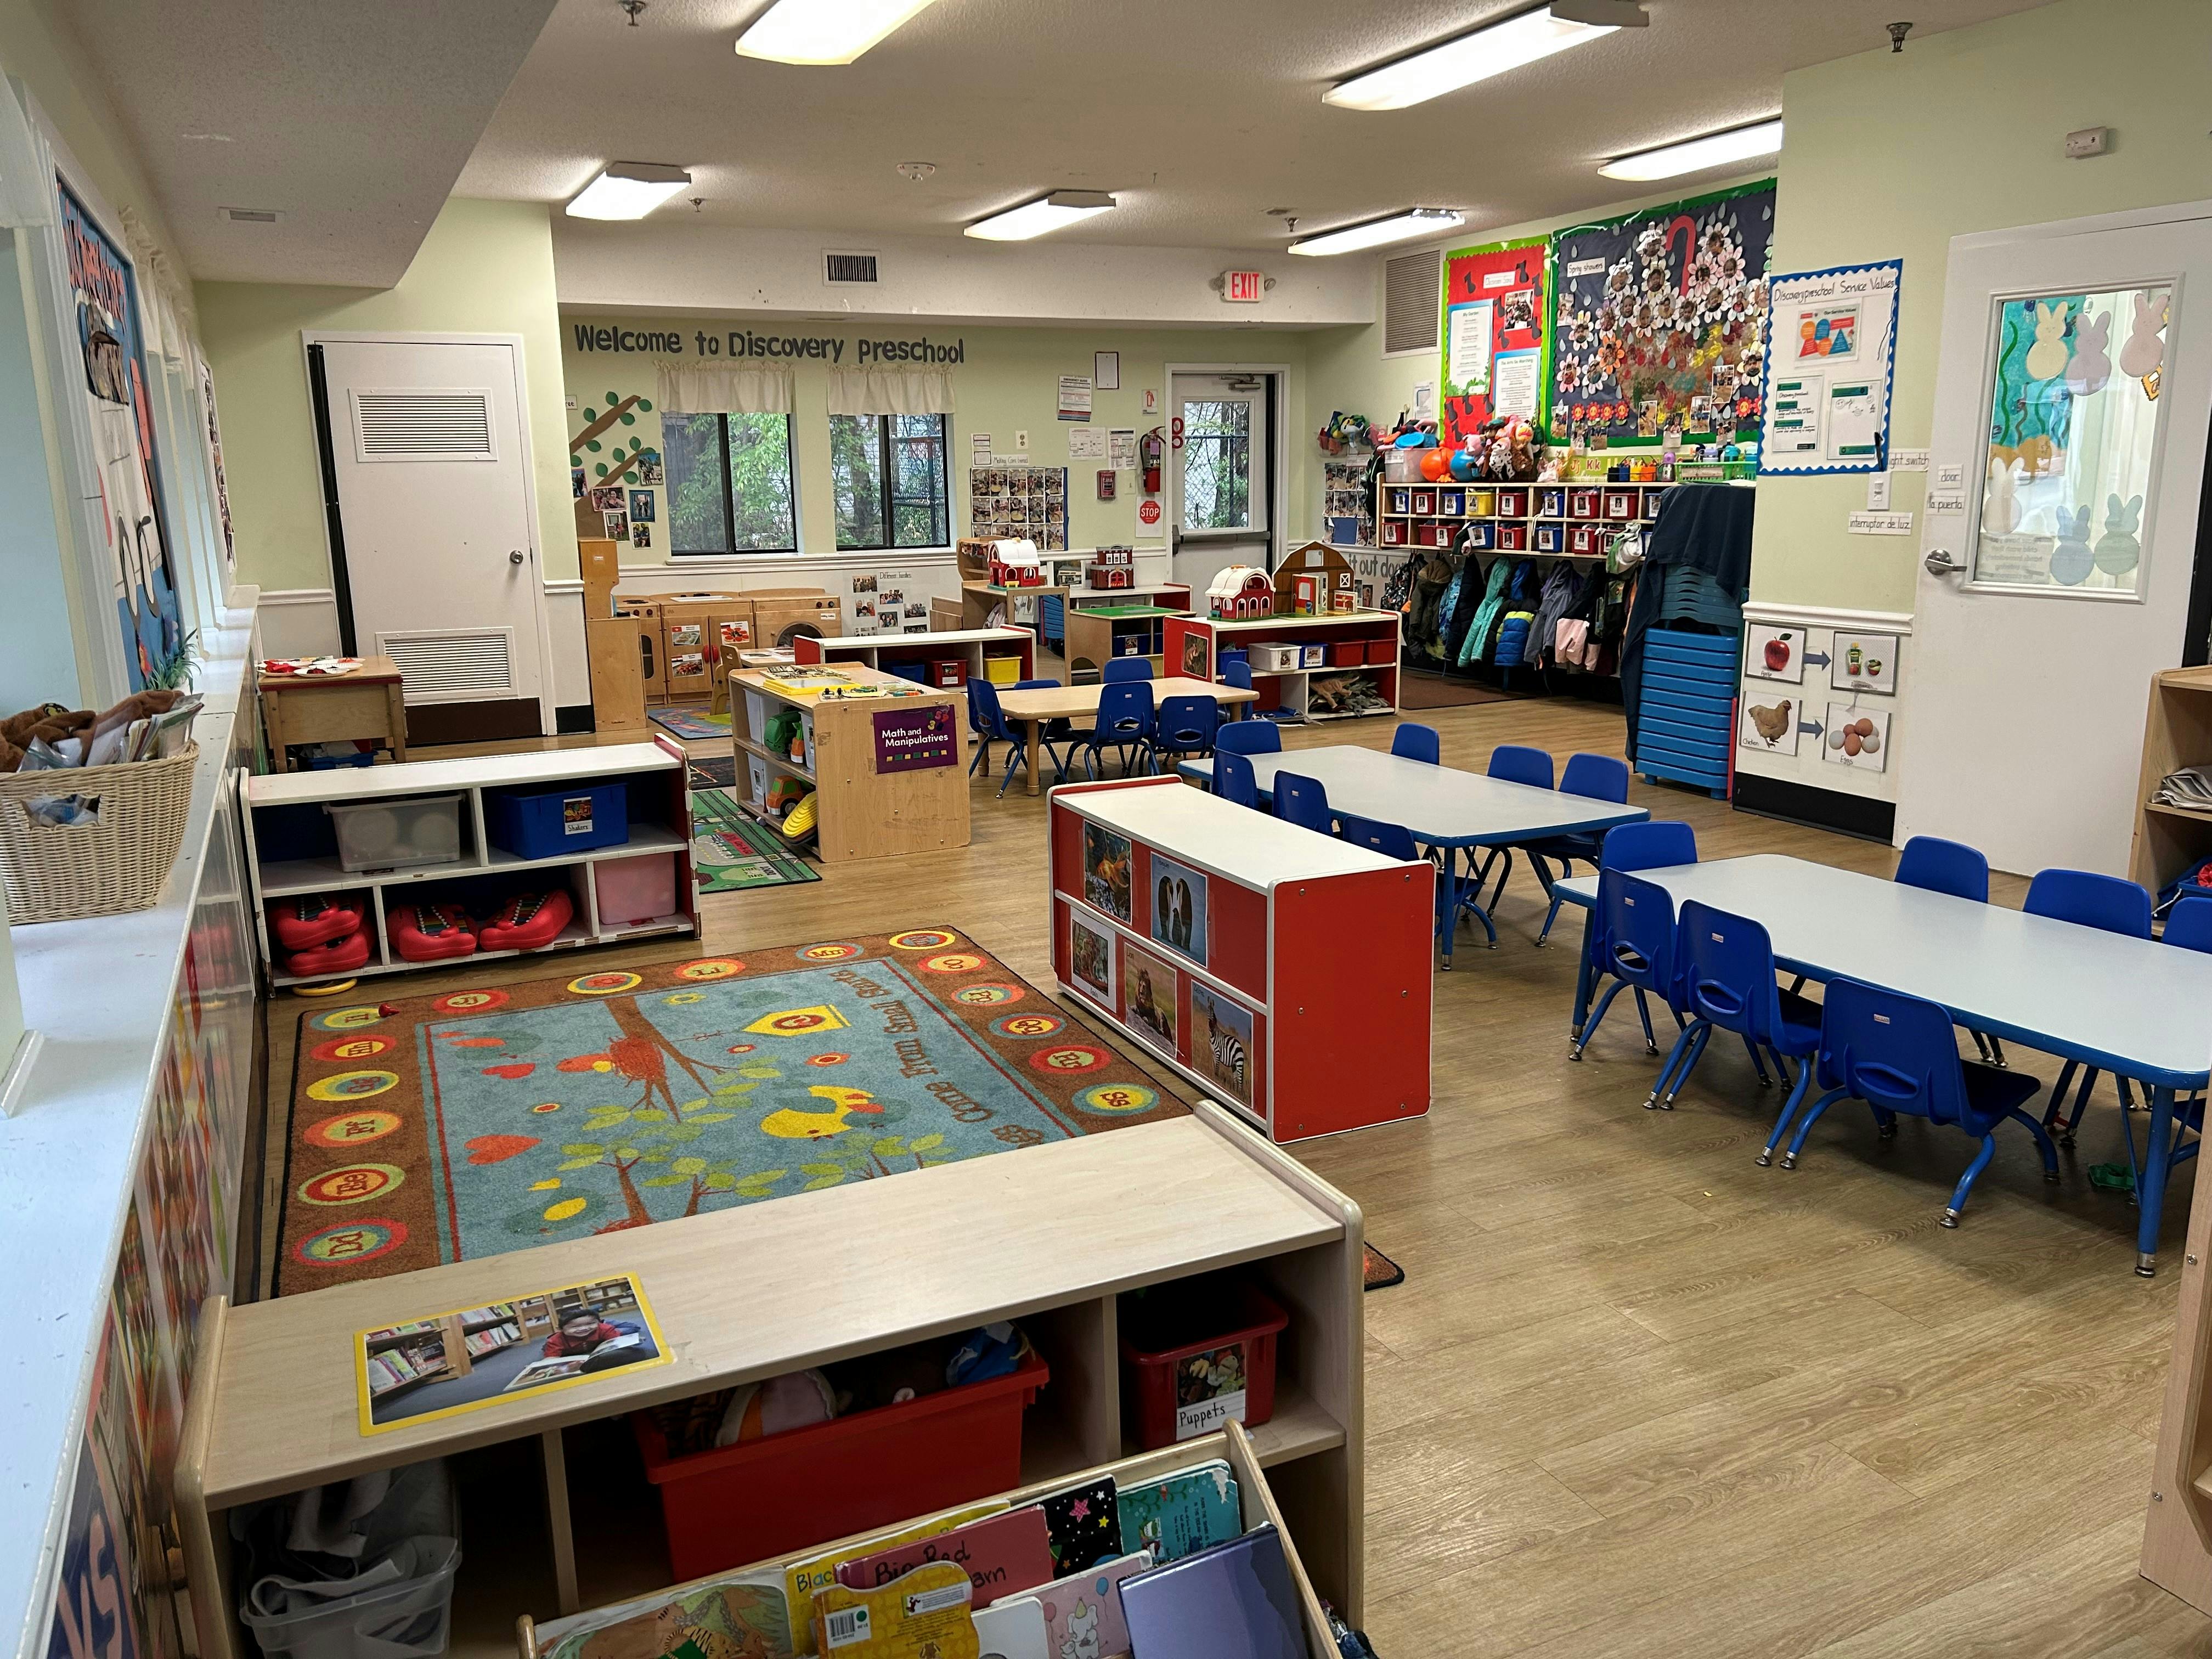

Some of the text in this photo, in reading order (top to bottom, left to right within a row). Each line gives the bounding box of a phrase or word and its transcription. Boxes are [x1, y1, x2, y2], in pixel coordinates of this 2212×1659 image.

[1232, 273, 1259, 299] EXIT
[1840, 280, 1867, 293] Service
[1870, 276, 1894, 290] Values
[574, 324, 964, 364] Welcome to Discovery preschool
[1585, 458, 1601, 471] Kk
[1889, 452, 1929, 469] ight switch
[1941, 469, 1960, 482] door
[1141, 508, 1159, 517] STOP
[1938, 496, 1962, 512] puerta
[1850, 516, 1910, 532] interruptor de luz
[1359, 555, 1378, 577] out
[882, 728, 906, 738] Math
[885, 733, 949, 747] Manipulatives
[1840, 755, 1853, 765] Eggs
[811, 947, 848, 959] Mm
[828, 969, 893, 998] Starts
[968, 990, 994, 1003] Pp
[870, 1000, 921, 1034] Small
[1015, 1019, 1044, 1035] Qq
[347, 1041, 374, 1057] Hh
[893, 1037, 939, 1079] From
[1052, 1052, 1082, 1068] Rr
[348, 1076, 382, 1094] Gg
[924, 1081, 993, 1123] Come
[1099, 1091, 1131, 1108] Ss
[345, 1120, 375, 1137] Ff
[336, 1172, 368, 1195] Ee
[327, 1231, 364, 1257] Dd
[1180, 1402, 1226, 1429] Puppets
[796, 1564, 837, 1593] Blac
[972, 1567, 1007, 1589] arn
